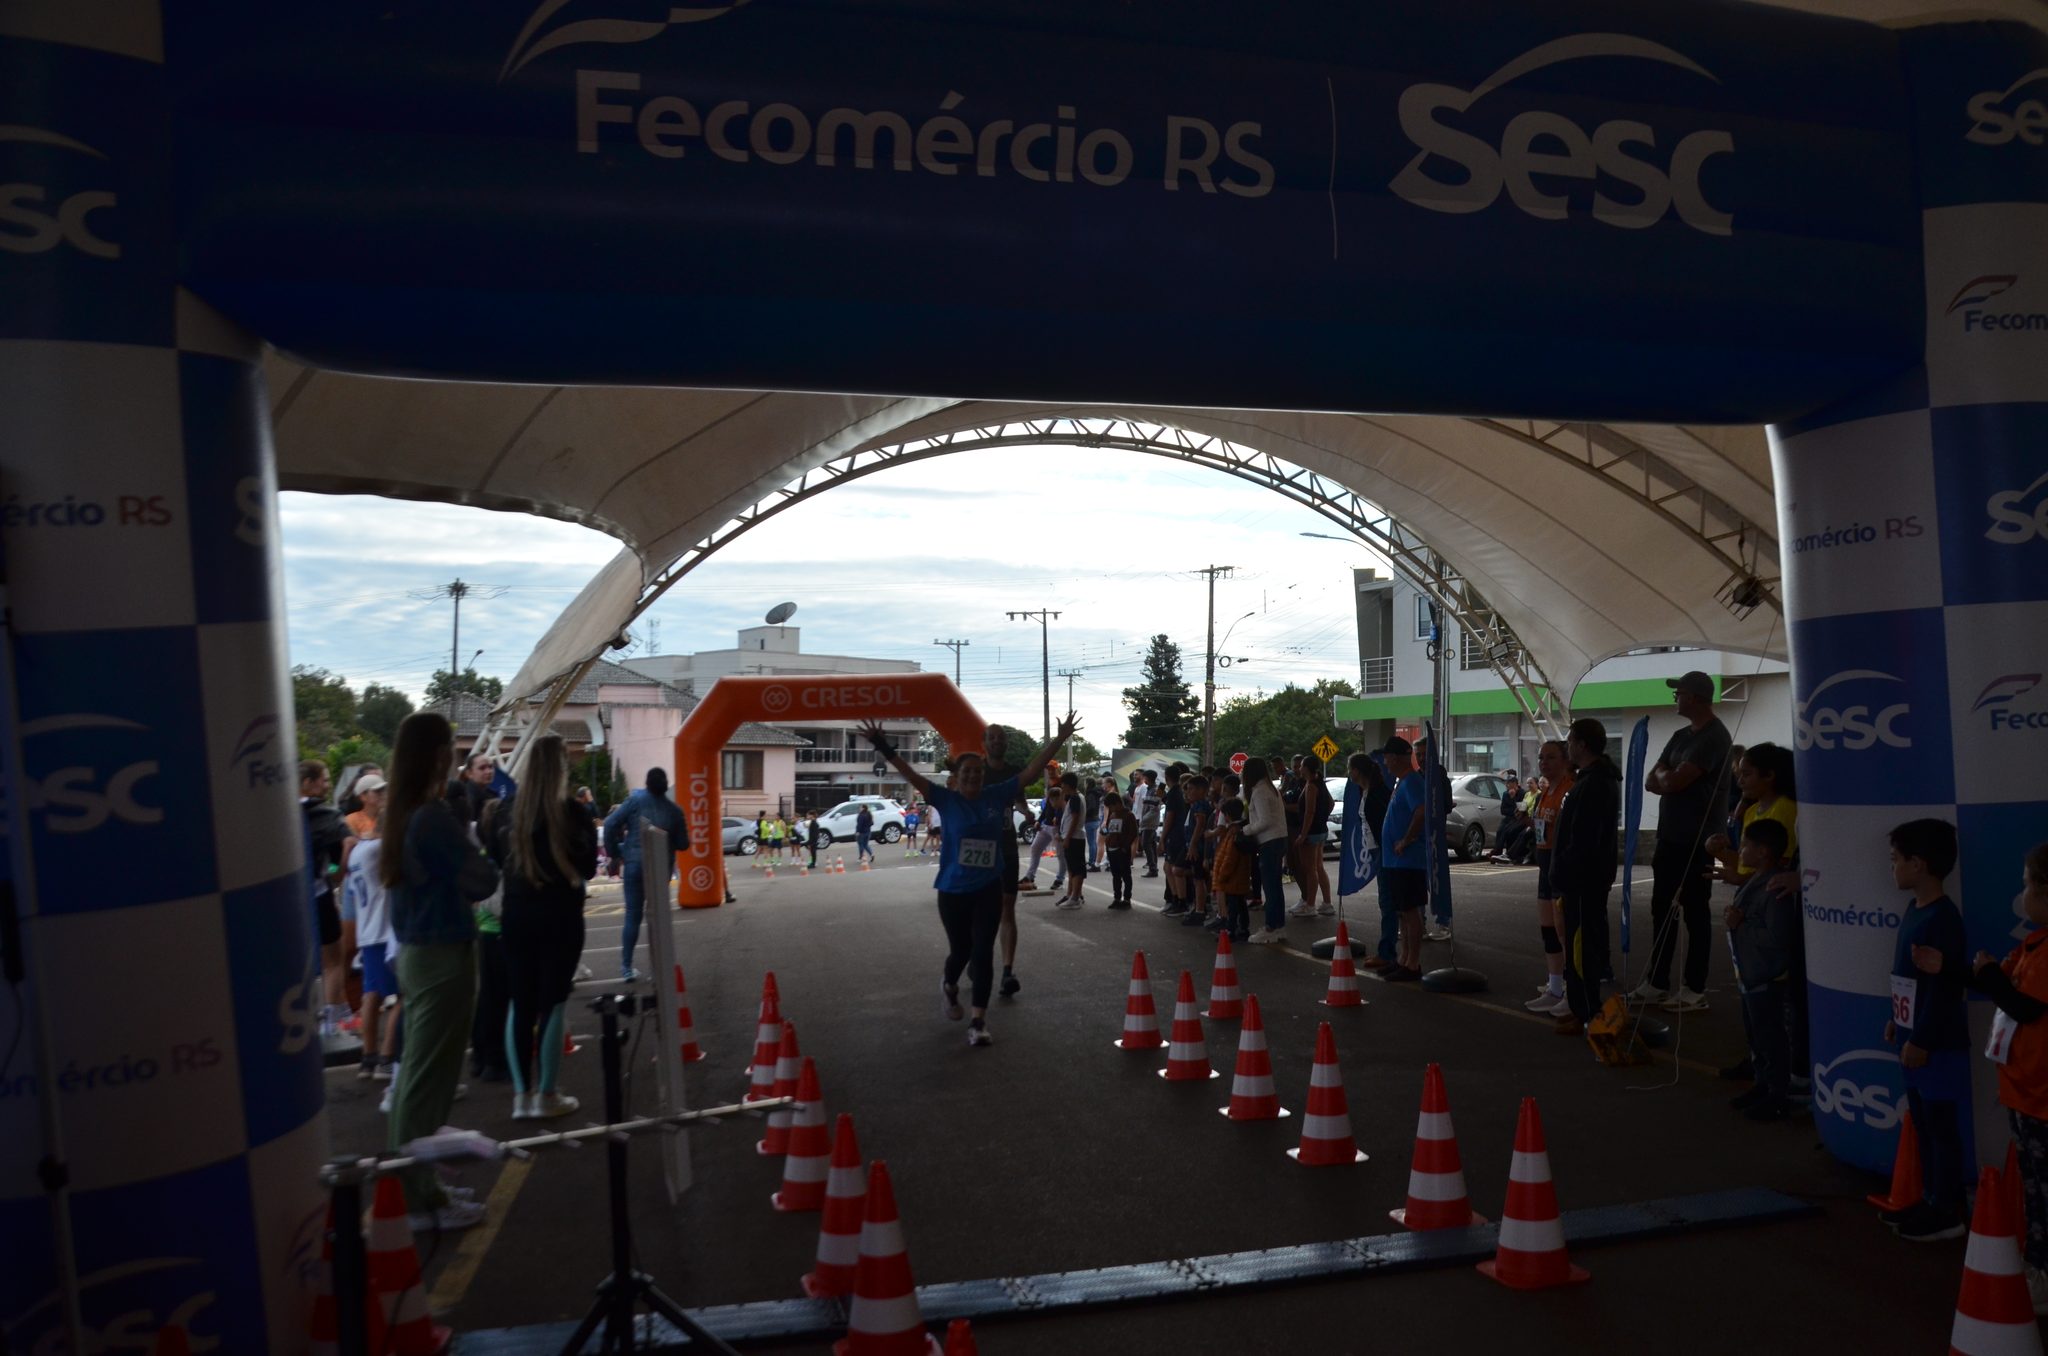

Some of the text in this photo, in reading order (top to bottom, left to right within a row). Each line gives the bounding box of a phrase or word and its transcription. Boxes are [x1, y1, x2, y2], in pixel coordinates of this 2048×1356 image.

[575, 68, 1277, 198] Fecomércio RS
[1387, 82, 1736, 237] Sesc
[118, 495, 173, 527] RS
[1884, 515, 1925, 540] RS
[801, 684, 912, 709] CRESOL
[1231, 759, 1246, 767] PAR
[688, 765, 711, 859] CRESOL
[963, 848, 992, 866] 278
[171, 1037, 223, 1074] RS
